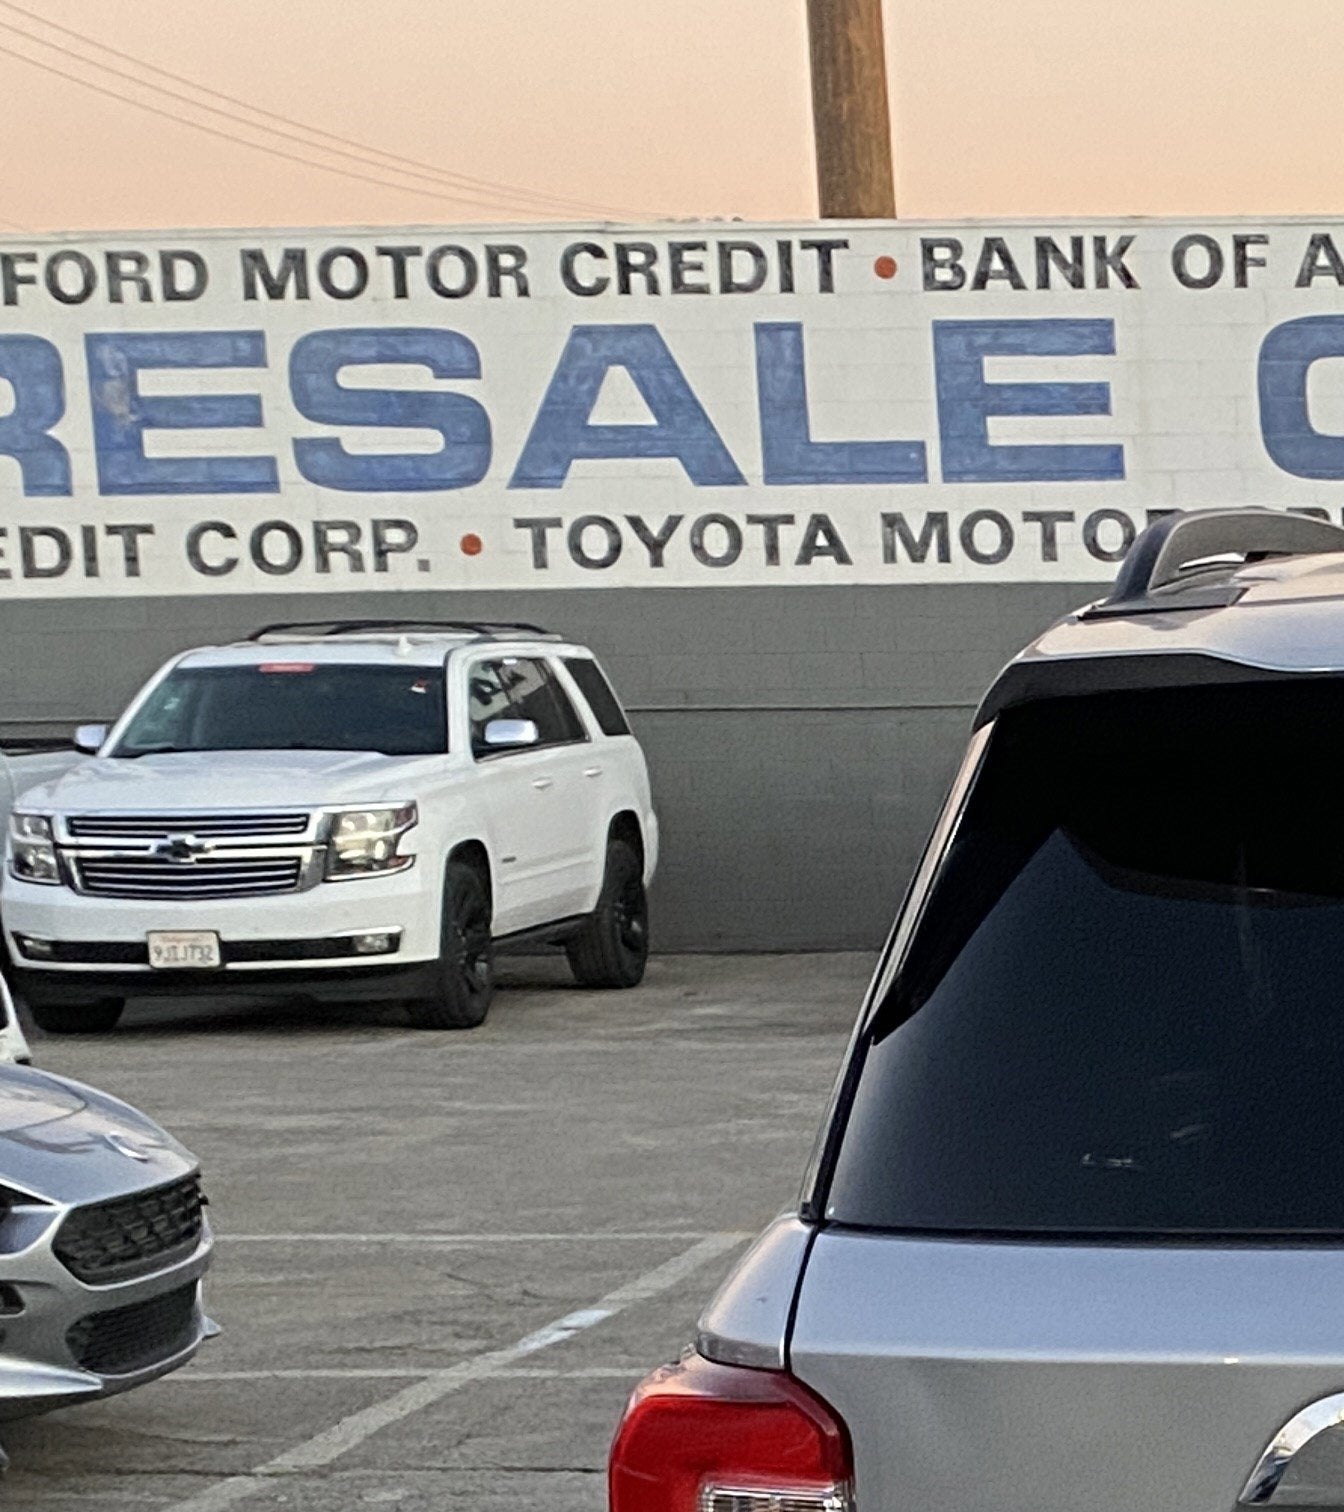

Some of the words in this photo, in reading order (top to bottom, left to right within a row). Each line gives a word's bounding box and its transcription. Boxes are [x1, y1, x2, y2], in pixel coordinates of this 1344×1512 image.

[1, 248, 209, 305] FORD
[239, 244, 531, 301] MOTOR
[560, 239, 850, 296] CREDIT
[919, 235, 1141, 291] BANK
[1170, 233, 1270, 289] OF
[0, 523, 154, 580] DIT
[185, 518, 430, 577] CORP.
[513, 511, 852, 570] TOYOTA
[882, 508, 1183, 565] MOTO
